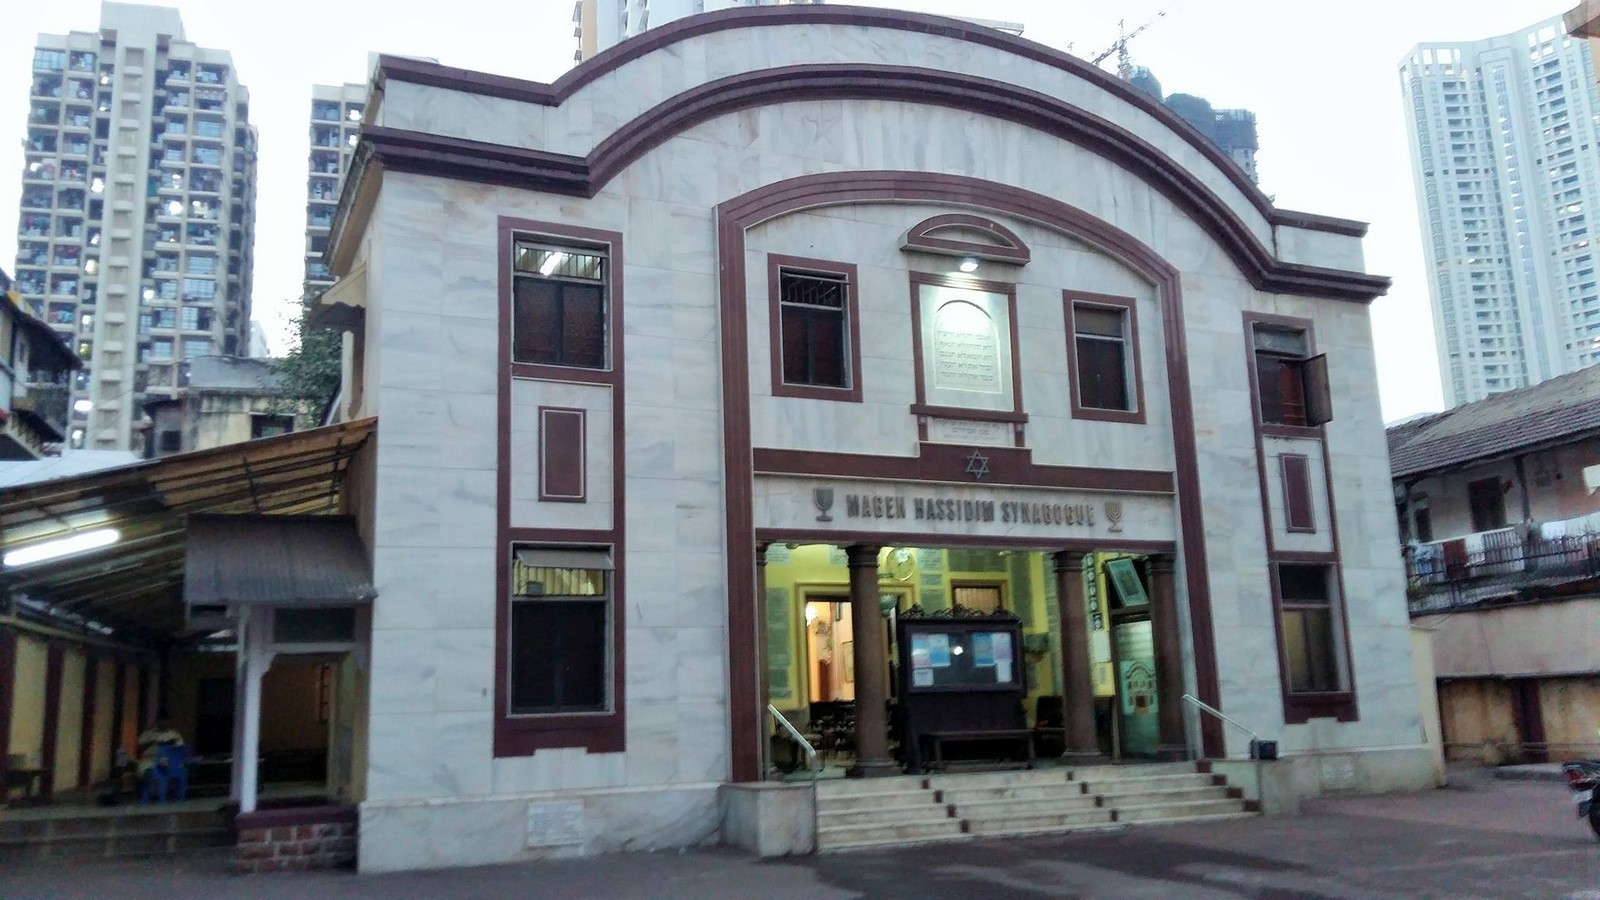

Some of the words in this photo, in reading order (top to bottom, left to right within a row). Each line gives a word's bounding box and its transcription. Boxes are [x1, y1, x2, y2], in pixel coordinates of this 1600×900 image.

[846, 494, 906, 519] MAGEN
[914, 497, 995, 522] HASSIDIM
[1001, 500, 1096, 527] SYNAGOGUE
